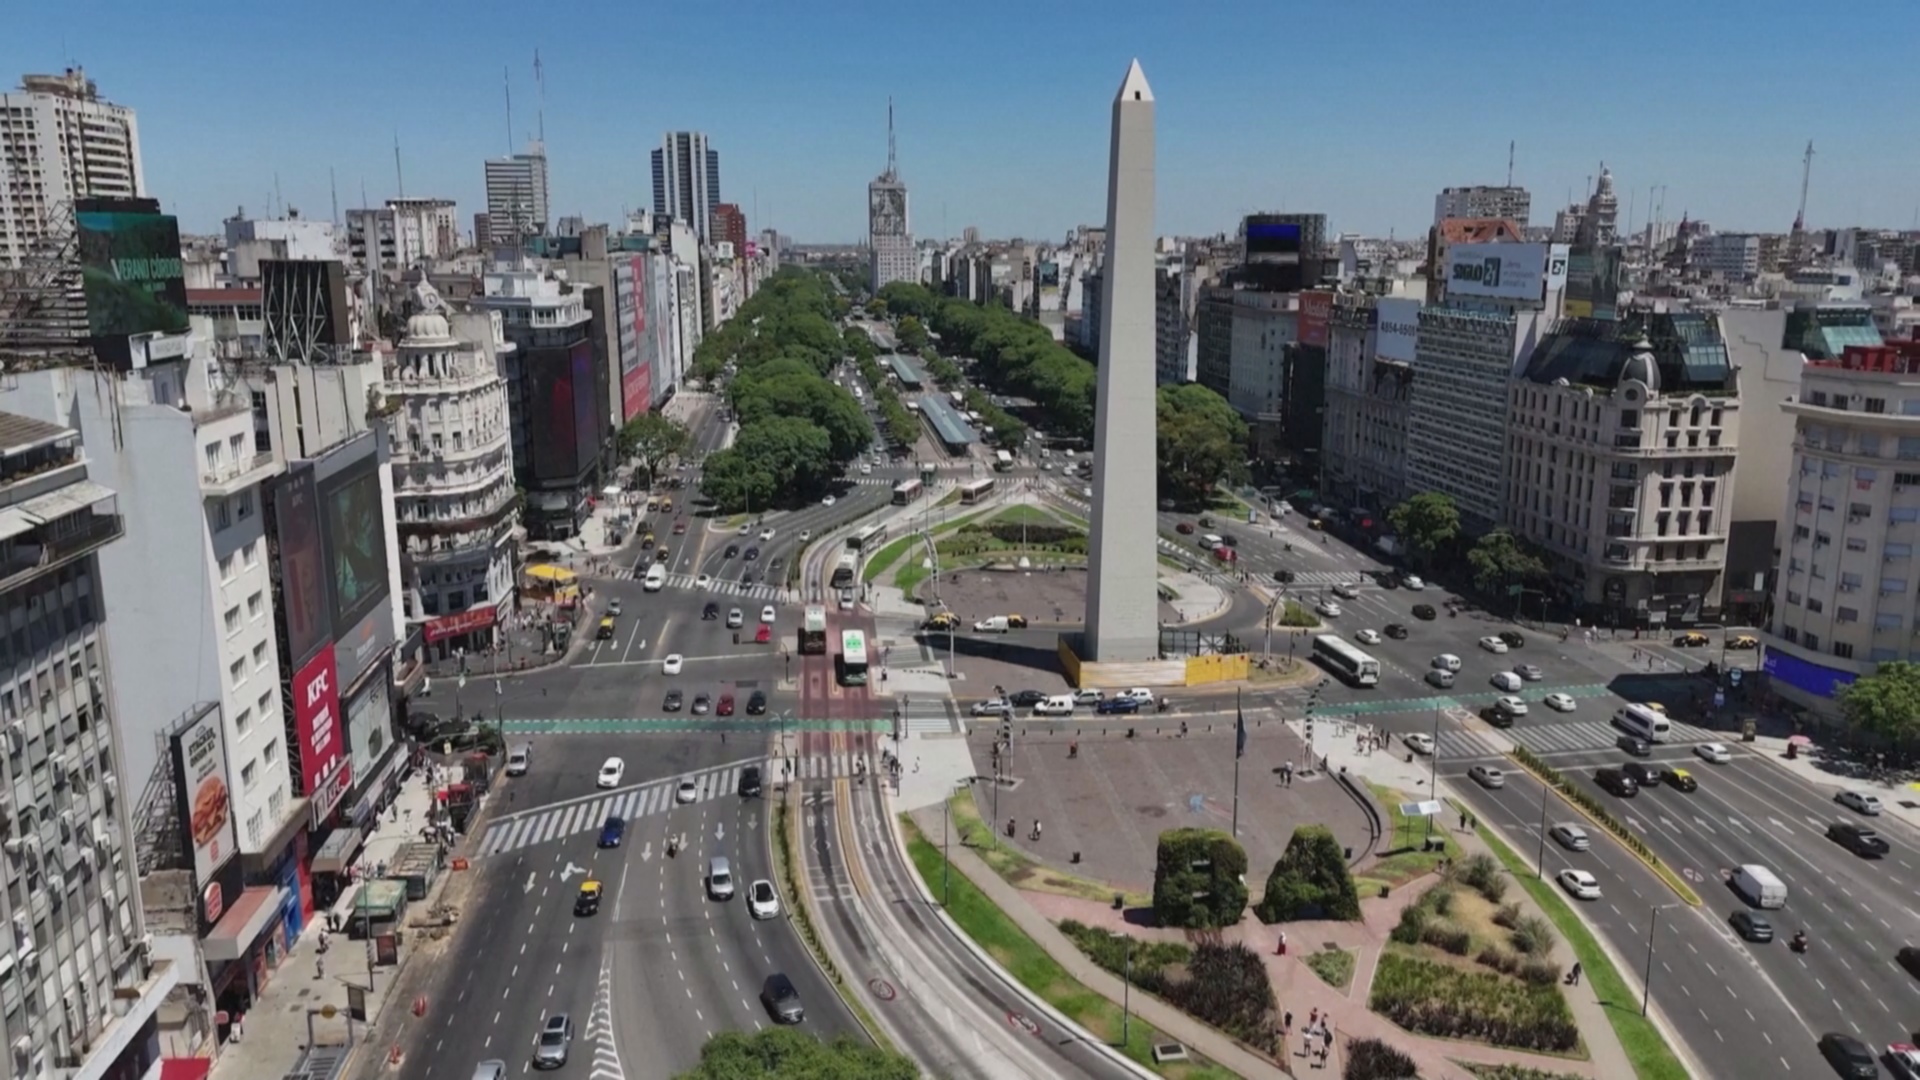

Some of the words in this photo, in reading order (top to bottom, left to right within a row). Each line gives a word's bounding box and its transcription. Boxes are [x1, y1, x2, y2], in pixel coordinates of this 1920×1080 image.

[110, 257, 149, 280] VERANO
[1453, 263, 1483, 282] SIGLO
[1552, 260, 1566, 275] 21
[307, 668, 329, 708] KFC
[328, 776, 345, 805] KFC
